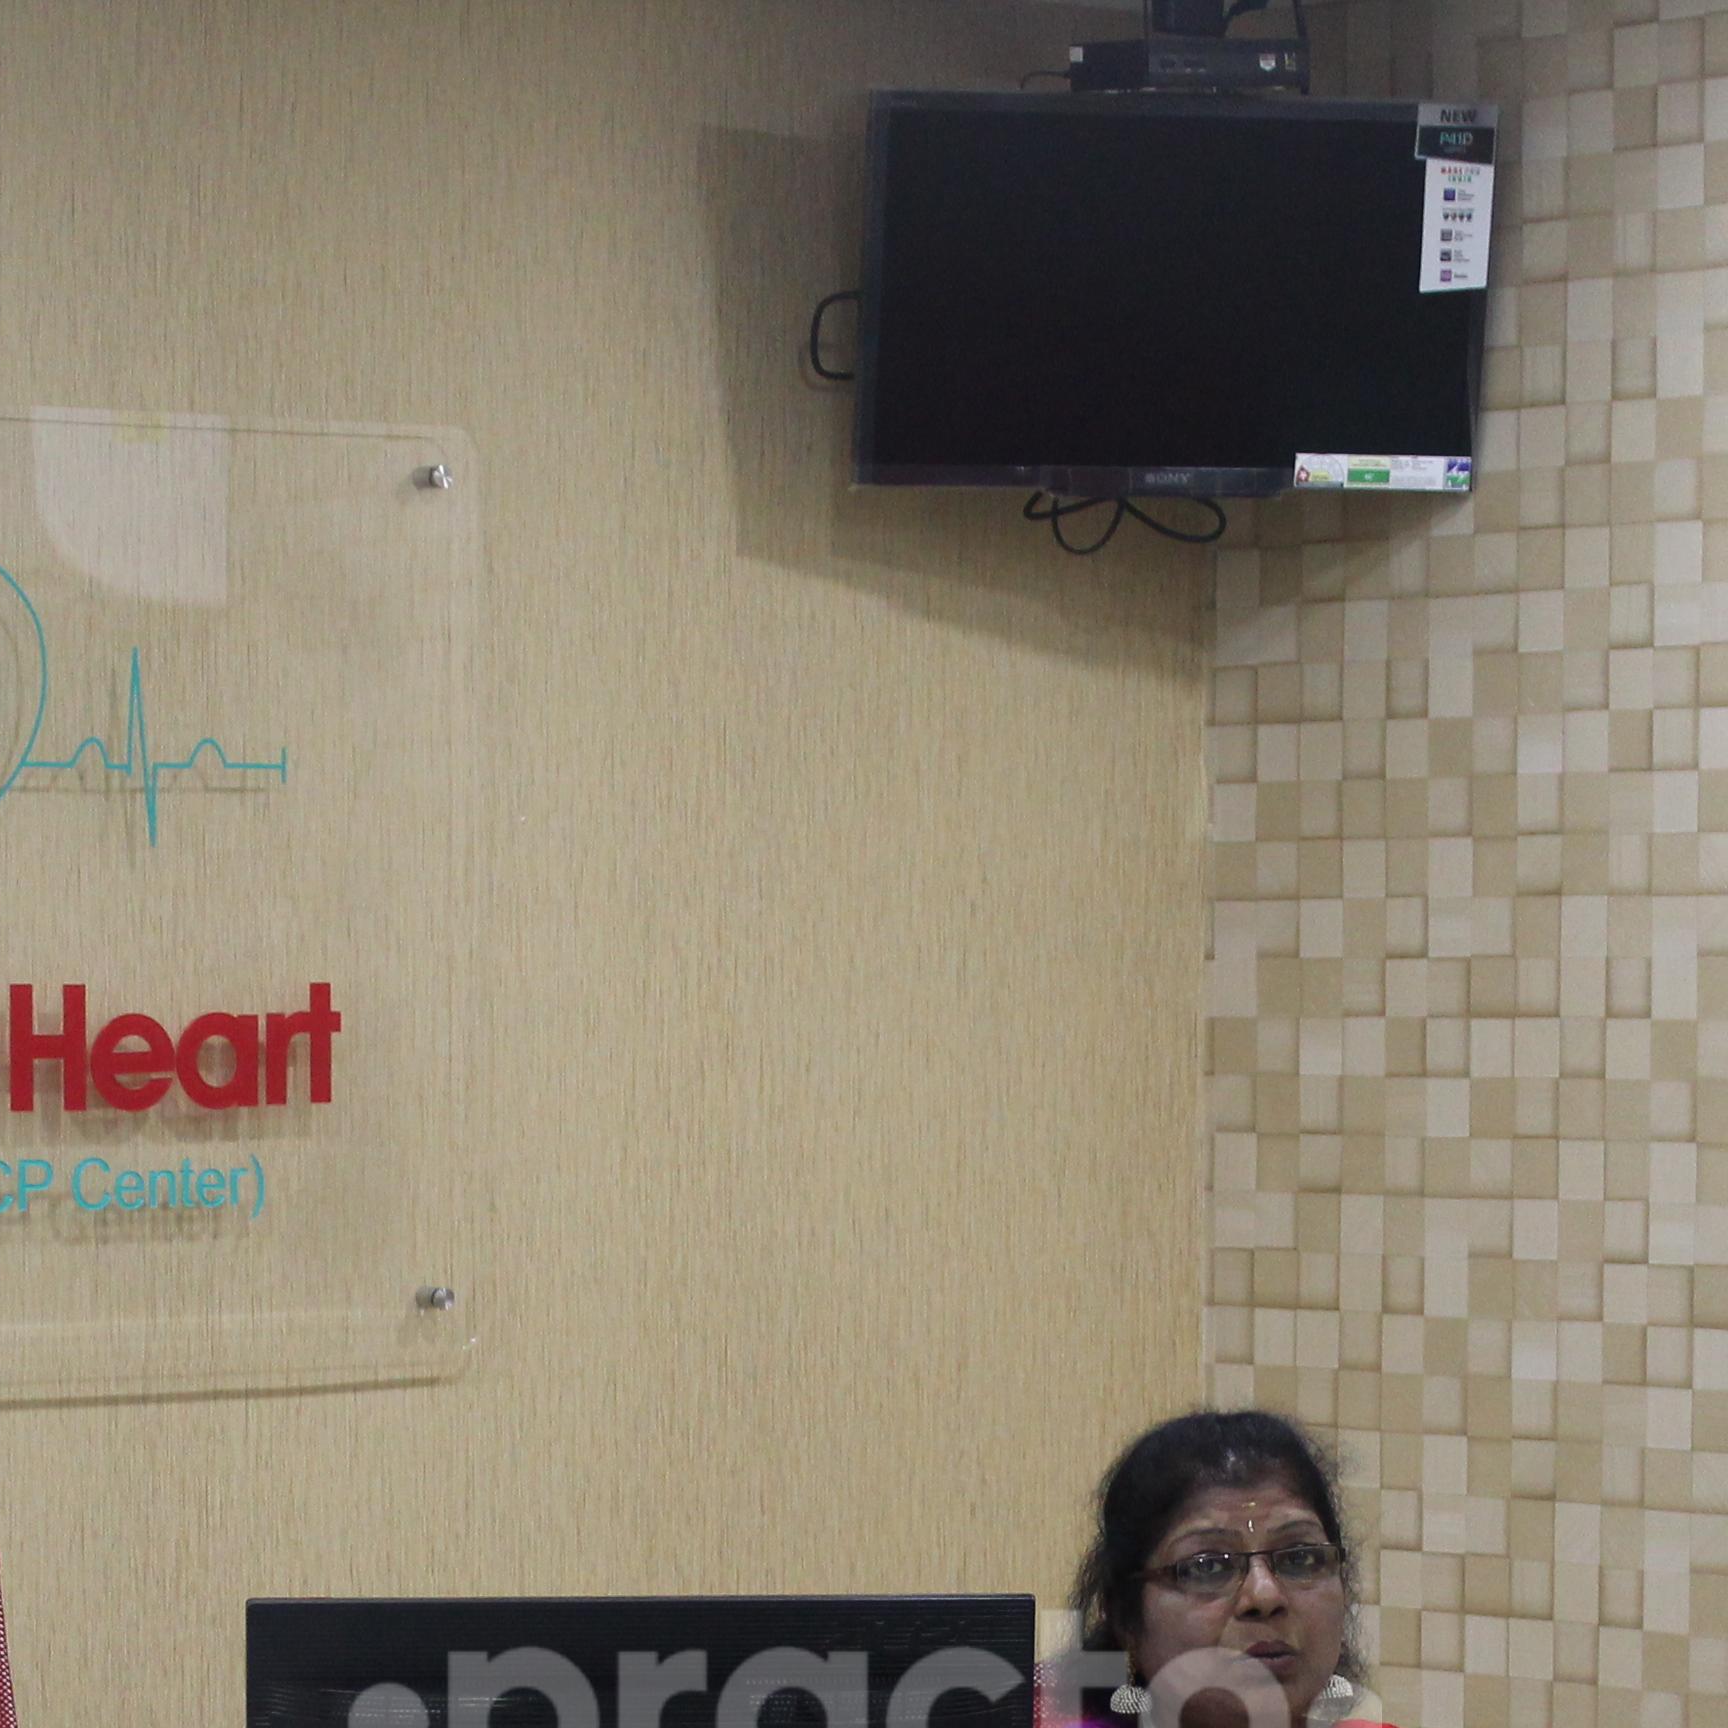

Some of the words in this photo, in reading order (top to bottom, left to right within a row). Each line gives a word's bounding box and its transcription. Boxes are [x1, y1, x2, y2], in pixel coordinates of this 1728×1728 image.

[1439, 109, 1477, 123] NEW
[8, 982, 341, 1112] Heart
[71, 1154, 267, 1220] Center)
